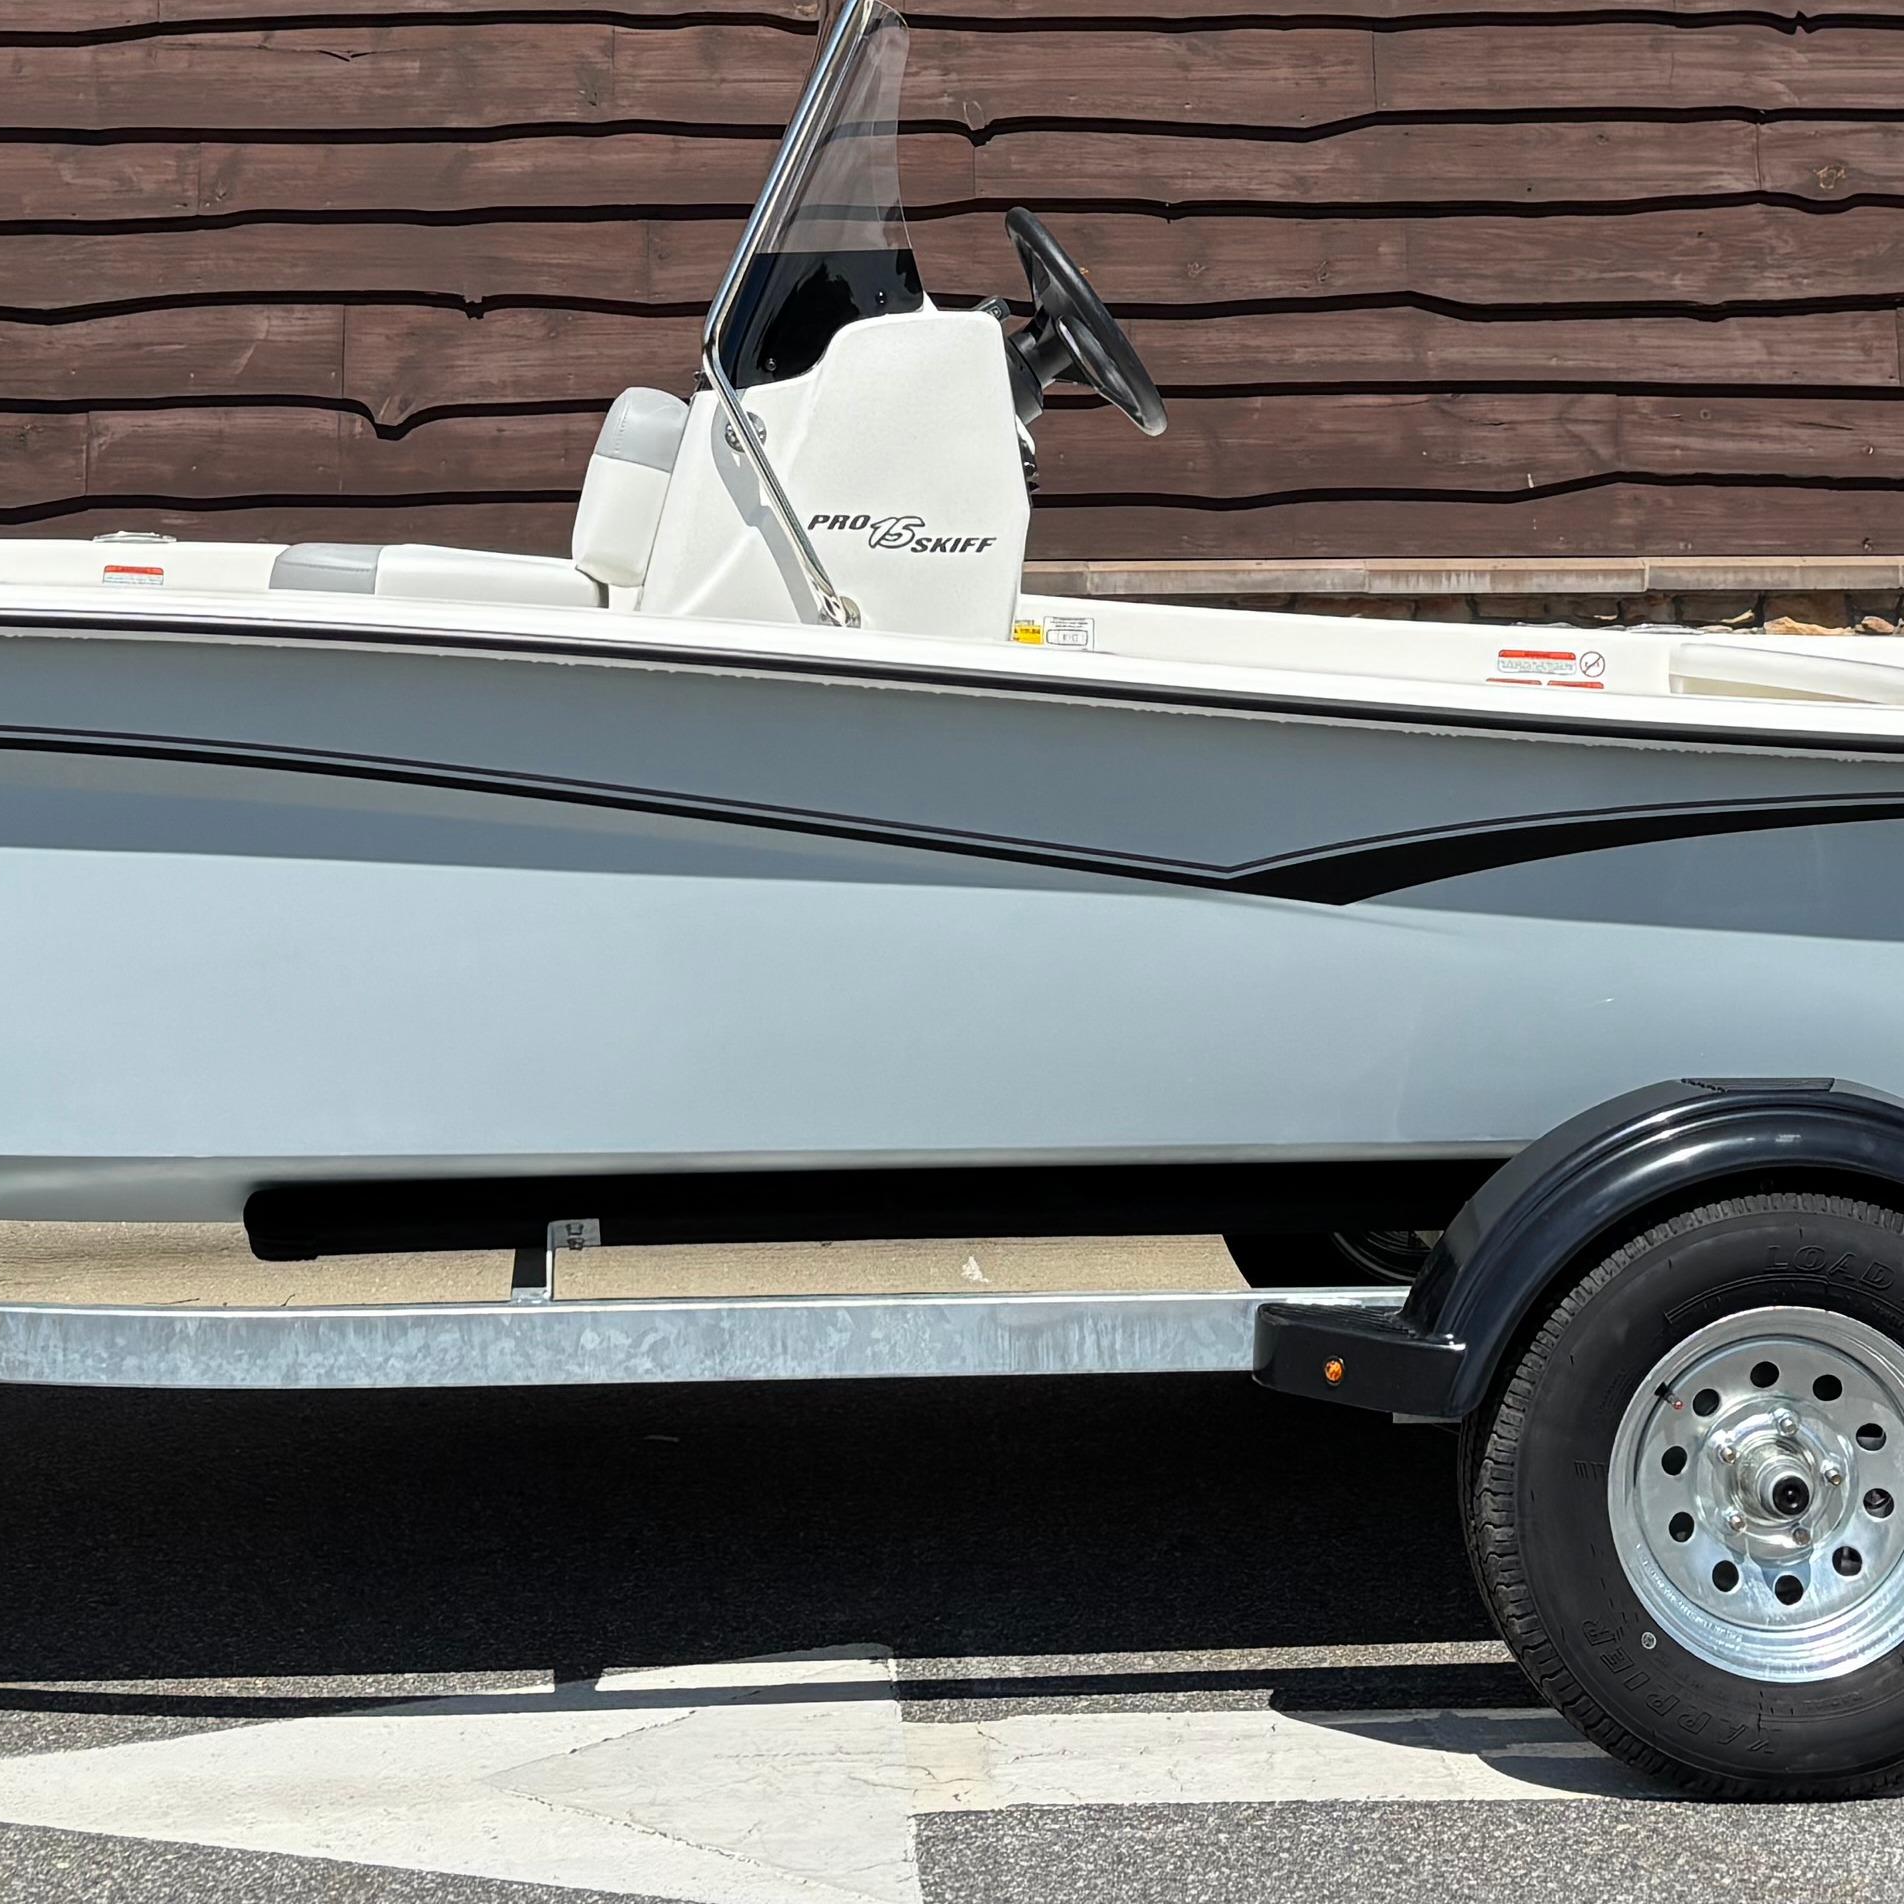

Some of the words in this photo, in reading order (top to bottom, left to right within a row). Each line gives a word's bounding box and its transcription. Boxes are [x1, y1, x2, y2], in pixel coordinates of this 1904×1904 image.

[807, 514, 871, 530] PRO
[868, 515, 926, 549] 15
[910, 537, 997, 553] SKIFF
[1764, 1245, 1896, 1290] LOAD
